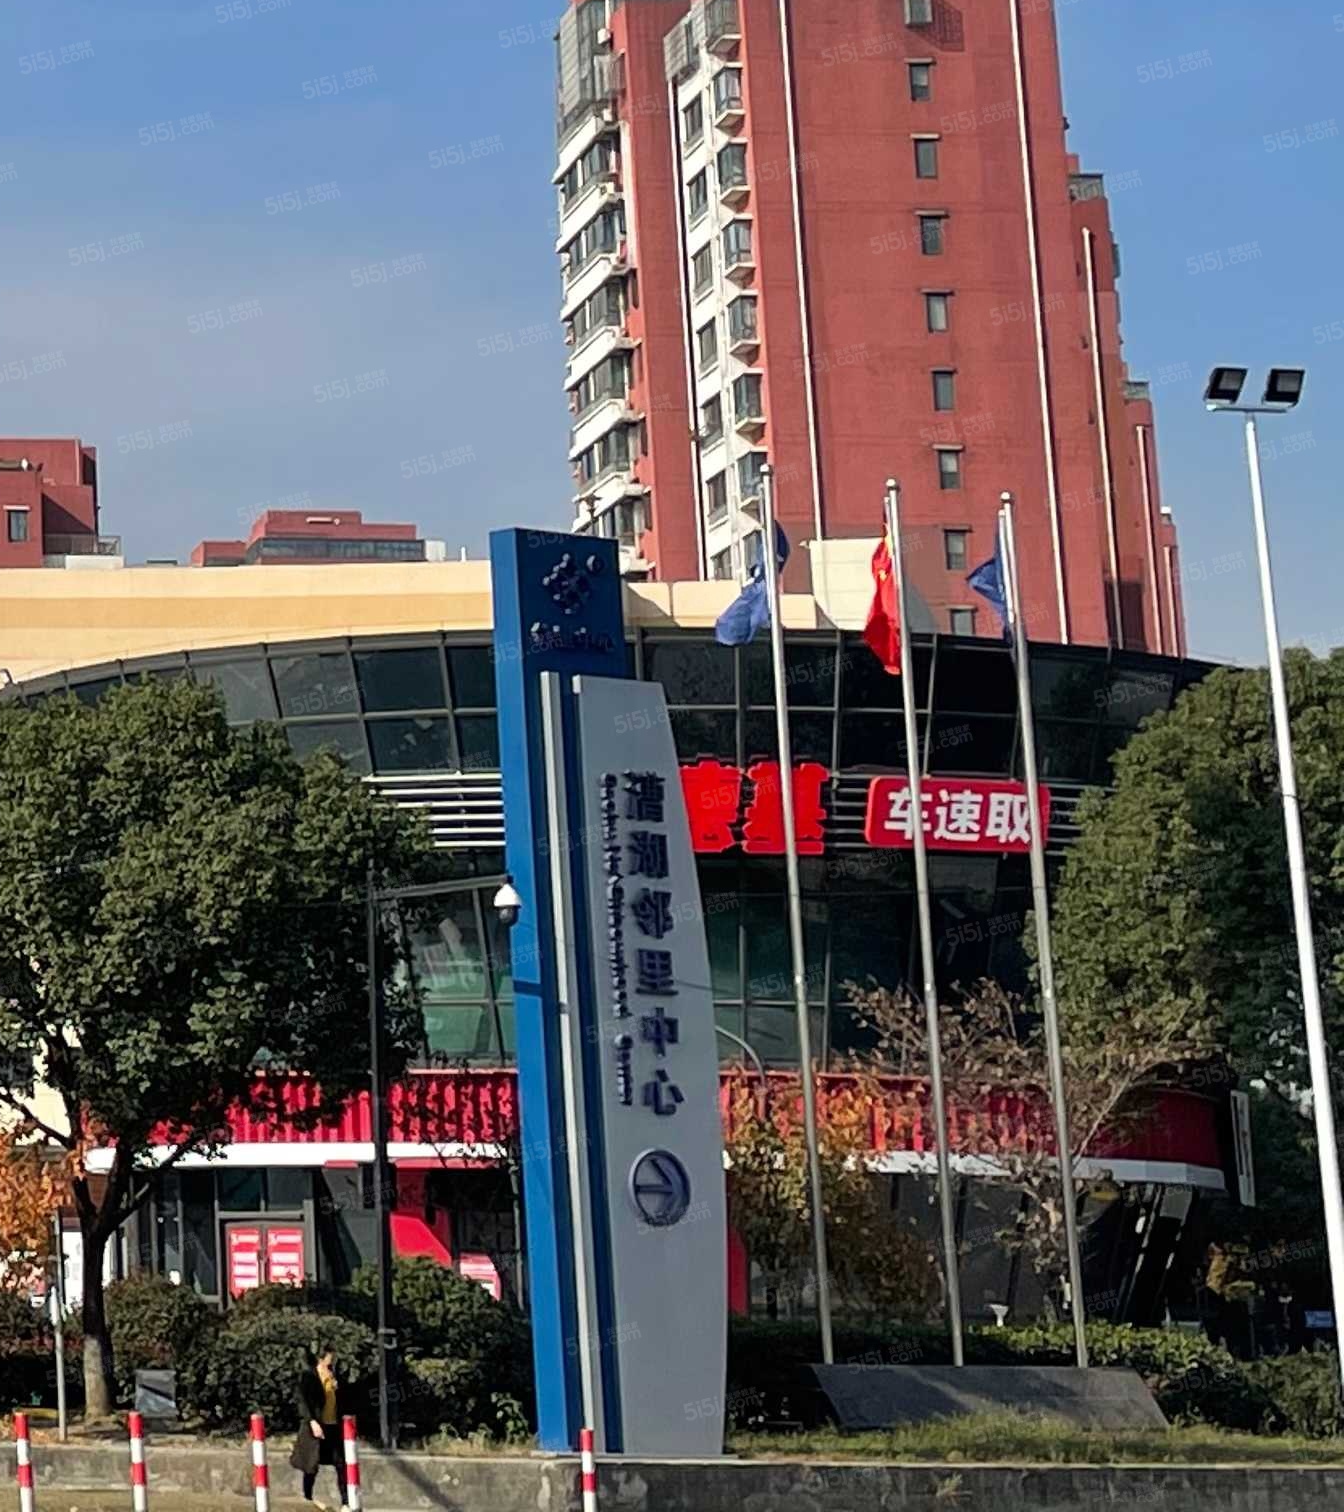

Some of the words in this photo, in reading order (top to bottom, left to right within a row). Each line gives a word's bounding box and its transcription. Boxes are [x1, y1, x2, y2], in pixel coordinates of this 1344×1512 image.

[883, 788, 1034, 844] 车速取
[622, 769, 685, 1116] 漕湖邻里中心
